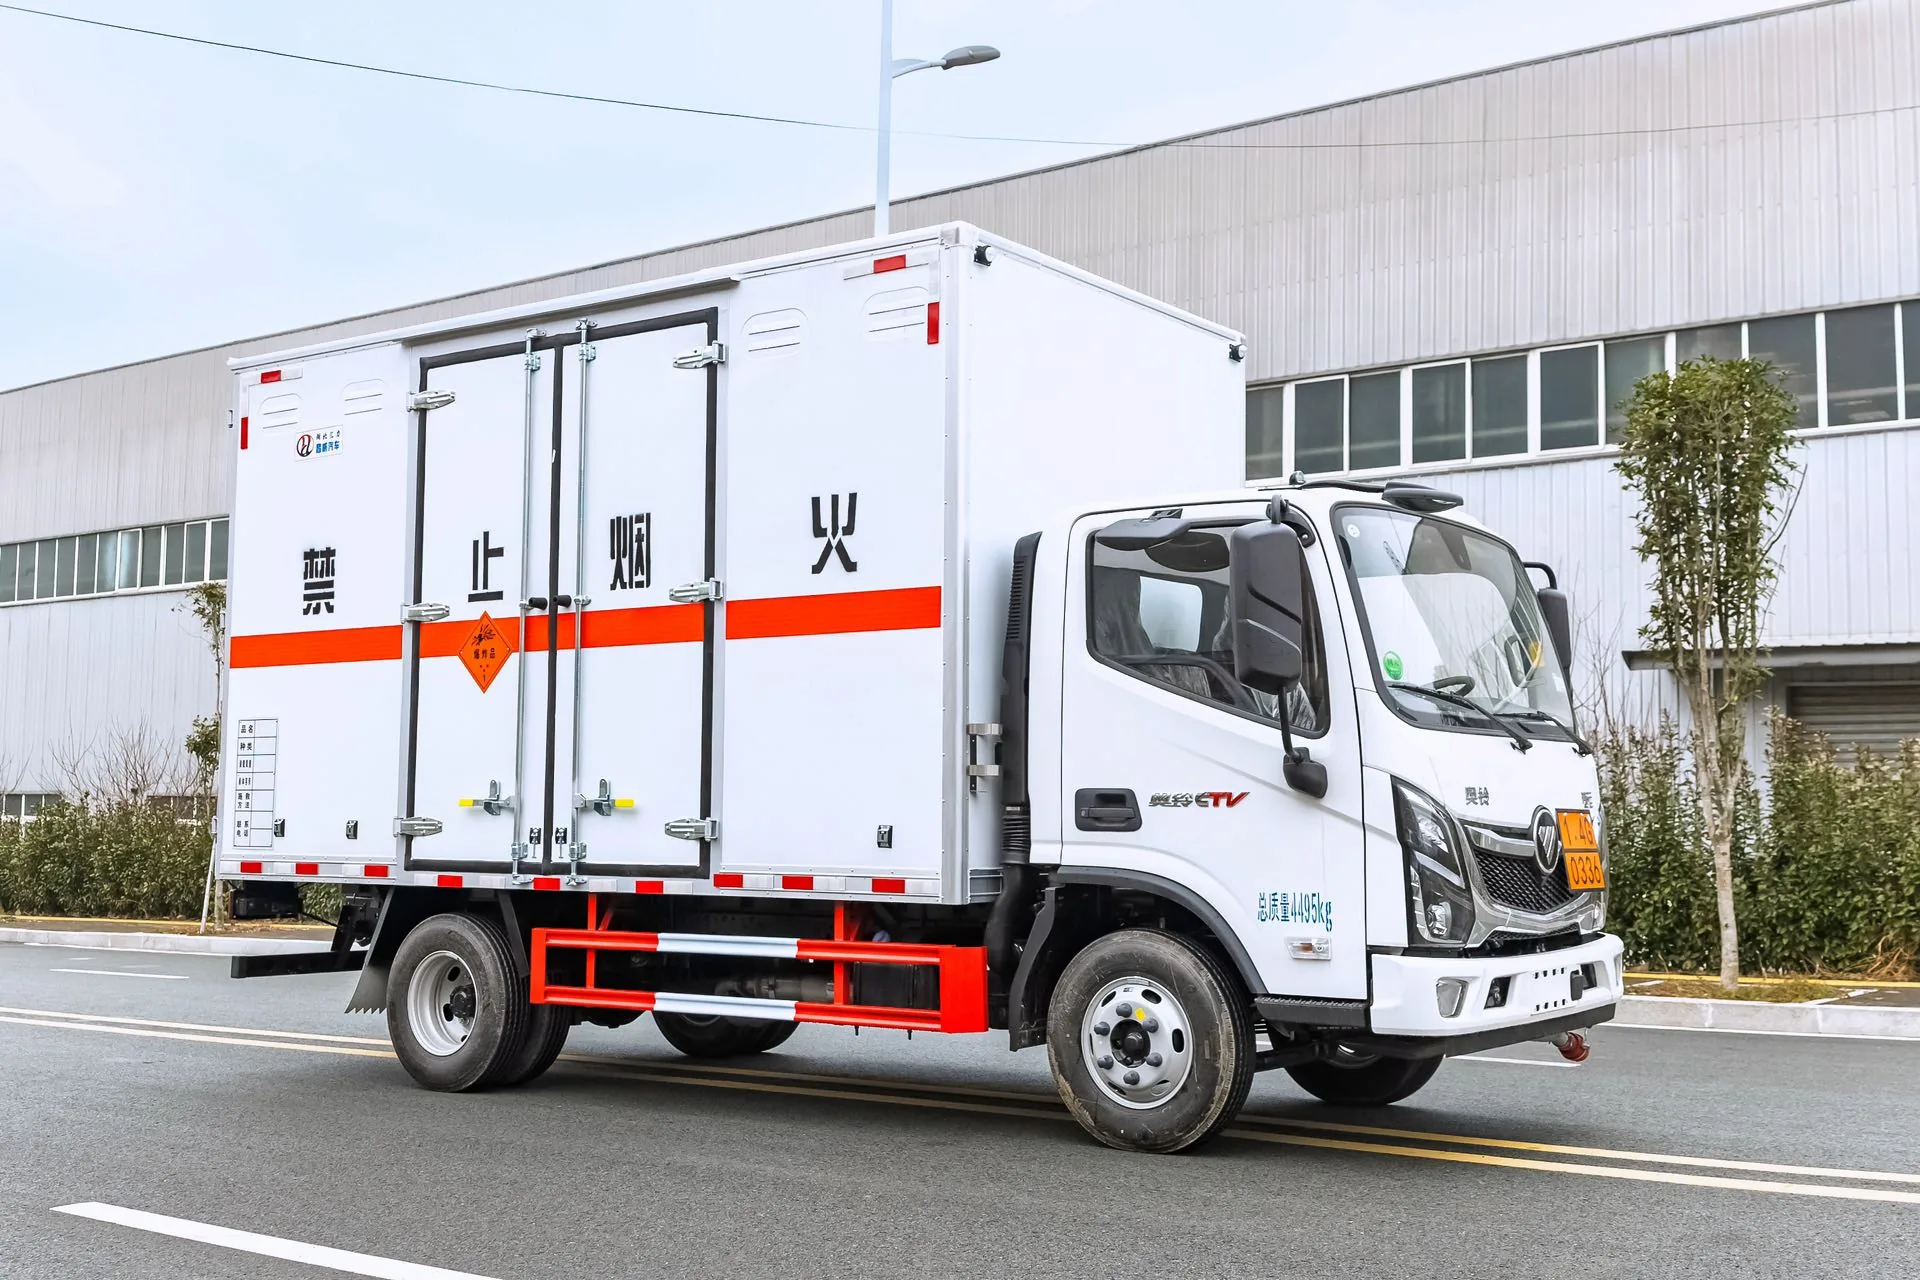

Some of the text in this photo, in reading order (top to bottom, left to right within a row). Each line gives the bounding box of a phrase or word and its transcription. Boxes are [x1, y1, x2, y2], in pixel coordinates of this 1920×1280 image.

[302, 492, 857, 615] 禁 止 烟 火
[1570, 855, 1602, 885] 0336
[1257, 891, 1333, 932] 总质量4495kg
